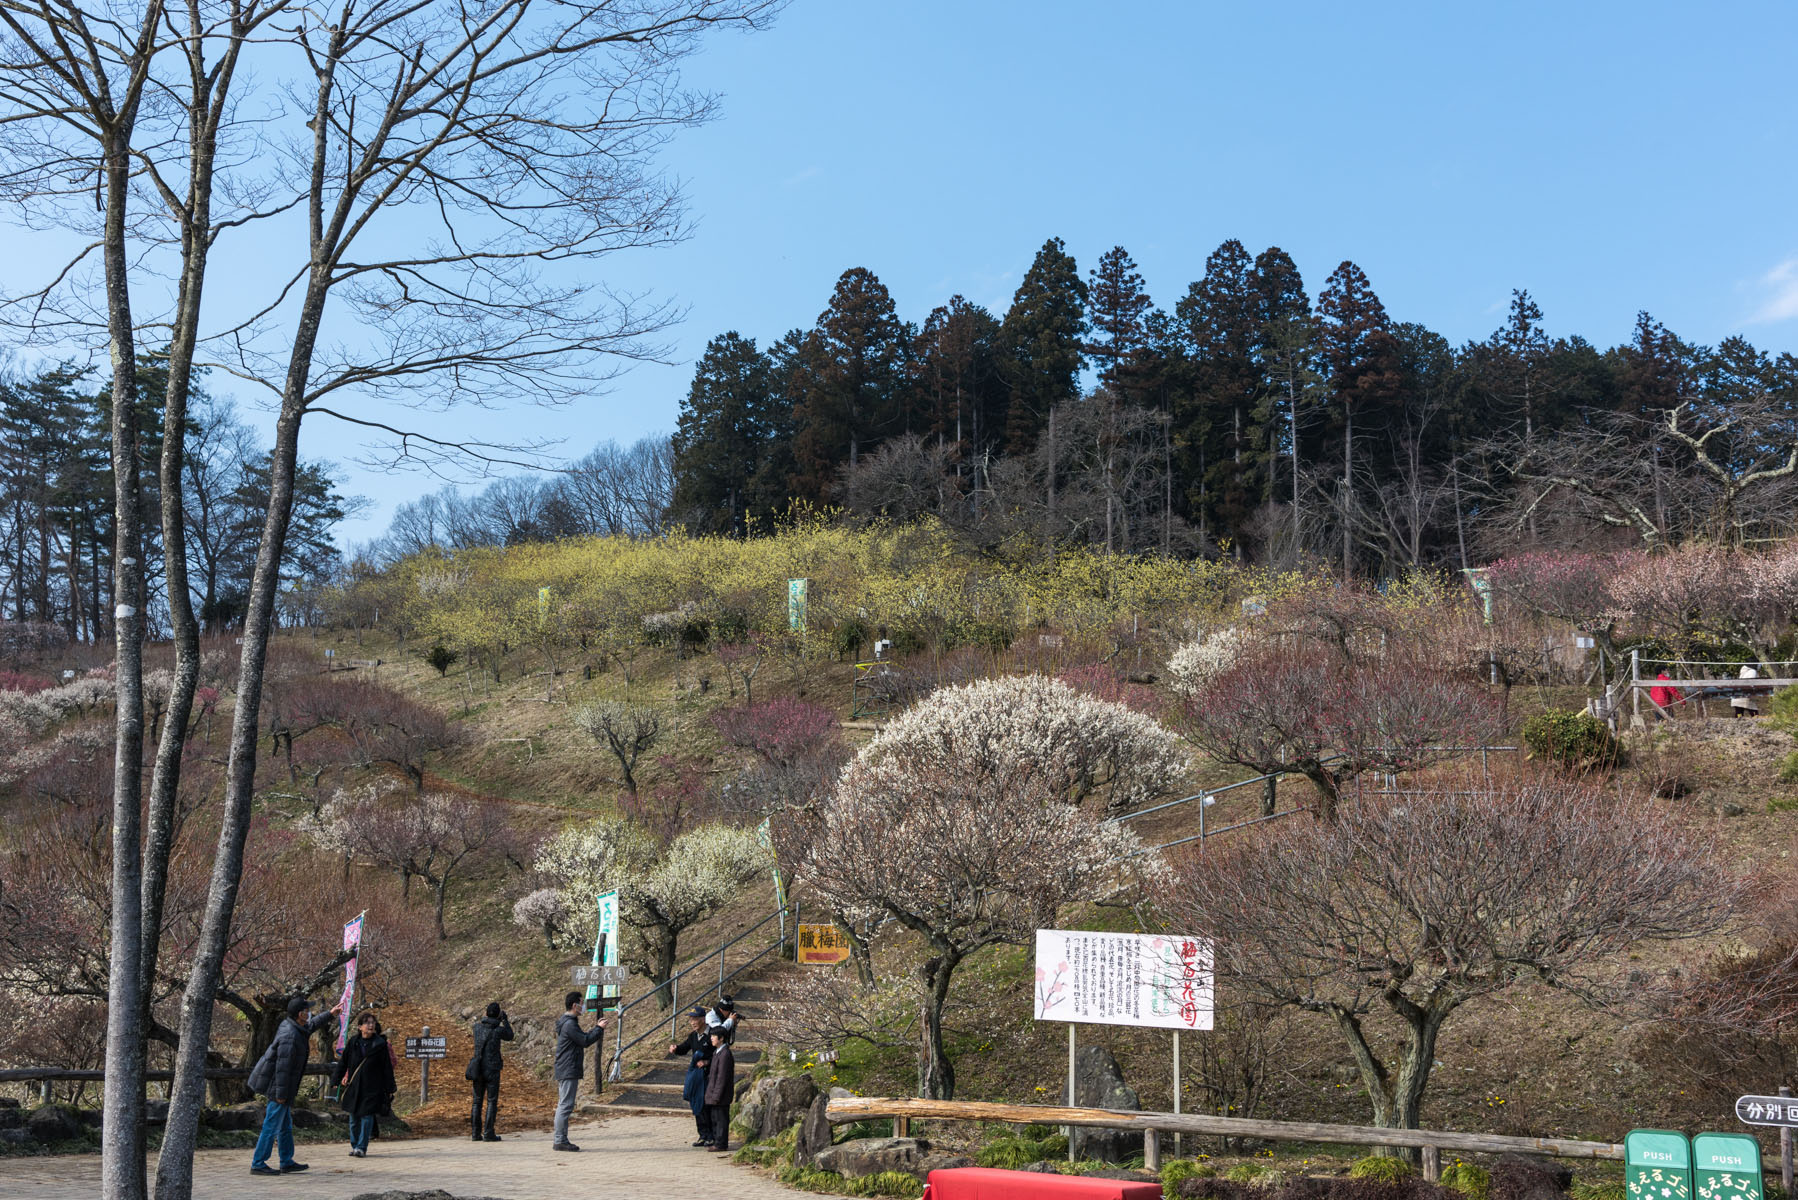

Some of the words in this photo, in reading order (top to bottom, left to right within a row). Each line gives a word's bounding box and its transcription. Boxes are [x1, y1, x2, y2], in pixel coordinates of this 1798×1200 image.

[575, 967, 626, 981] 梅百花園
[1181, 941, 1198, 1027] 梅百花園
[1643, 1151, 1672, 1161] PUSH
[1712, 1155, 1742, 1165] PUSH
[1629, 1169, 1688, 1198] もえるゴミ
[1698, 1173, 1759, 1200] もえるゴミ
